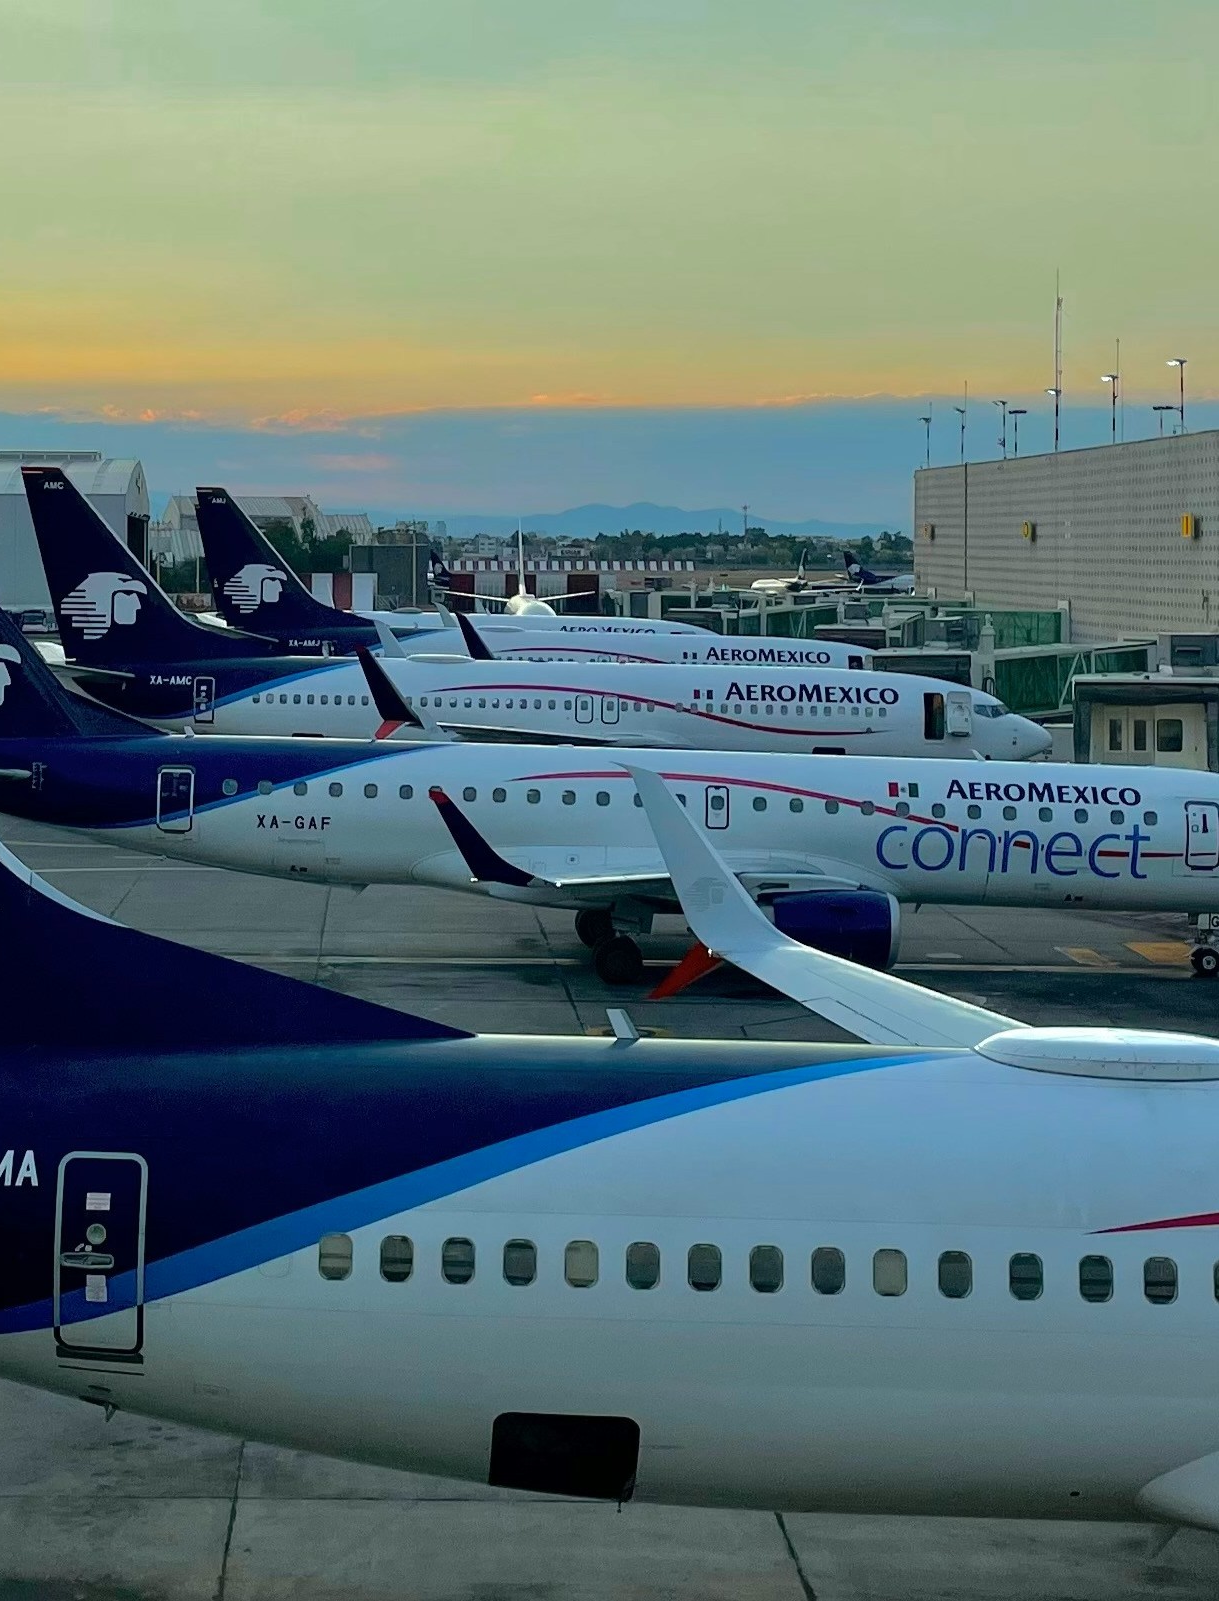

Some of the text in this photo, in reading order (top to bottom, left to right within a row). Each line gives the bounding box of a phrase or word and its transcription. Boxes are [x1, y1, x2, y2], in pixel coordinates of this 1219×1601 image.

[43, 481, 65, 490] AMC
[706, 646, 831, 664] AEROMEXICO
[149, 675, 193, 685] XA-AMC
[725, 682, 900, 705] AEROMEXICO
[946, 779, 1142, 806] AEROMEXICO
[256, 814, 332, 831] XA-GAF
[876, 823, 1151, 879] connect
